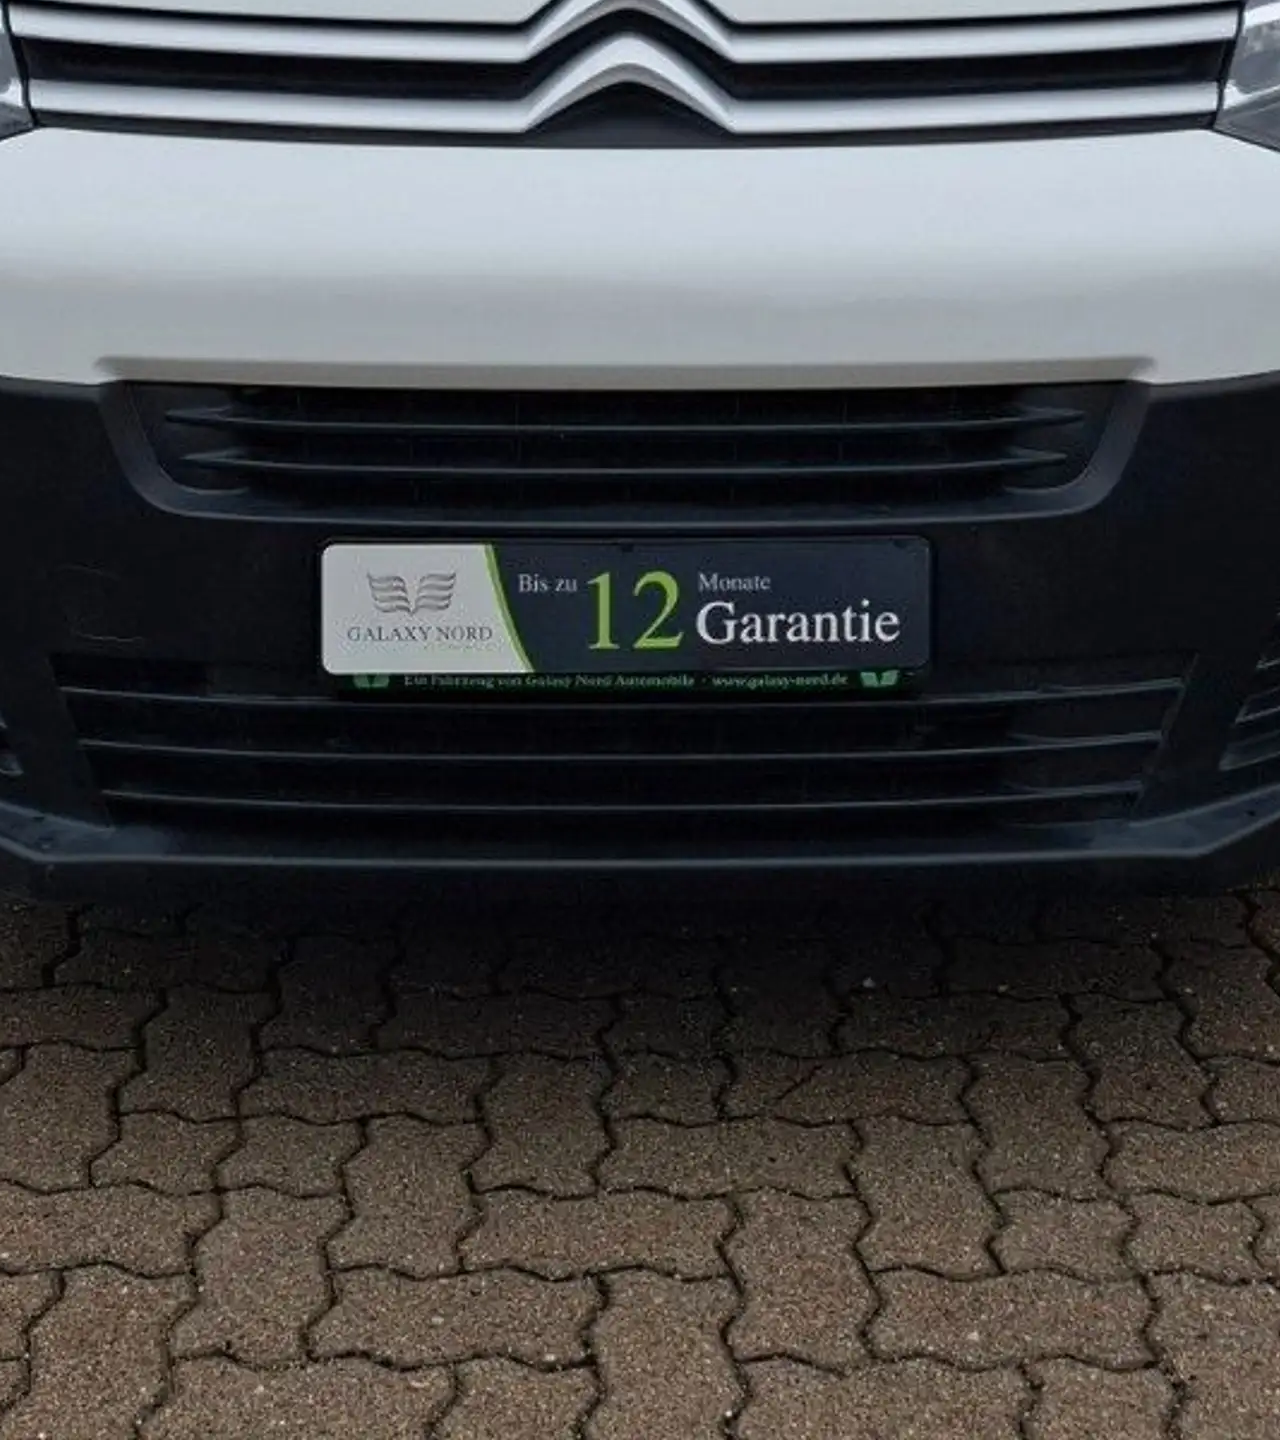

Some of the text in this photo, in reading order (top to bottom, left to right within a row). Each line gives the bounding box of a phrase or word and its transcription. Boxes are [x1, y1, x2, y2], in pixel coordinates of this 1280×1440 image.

[347, 625, 493, 642] GALAXY NORD
[518, 570, 771, 650] Bis zu 12 Monate
[695, 598, 901, 645] Garantie
